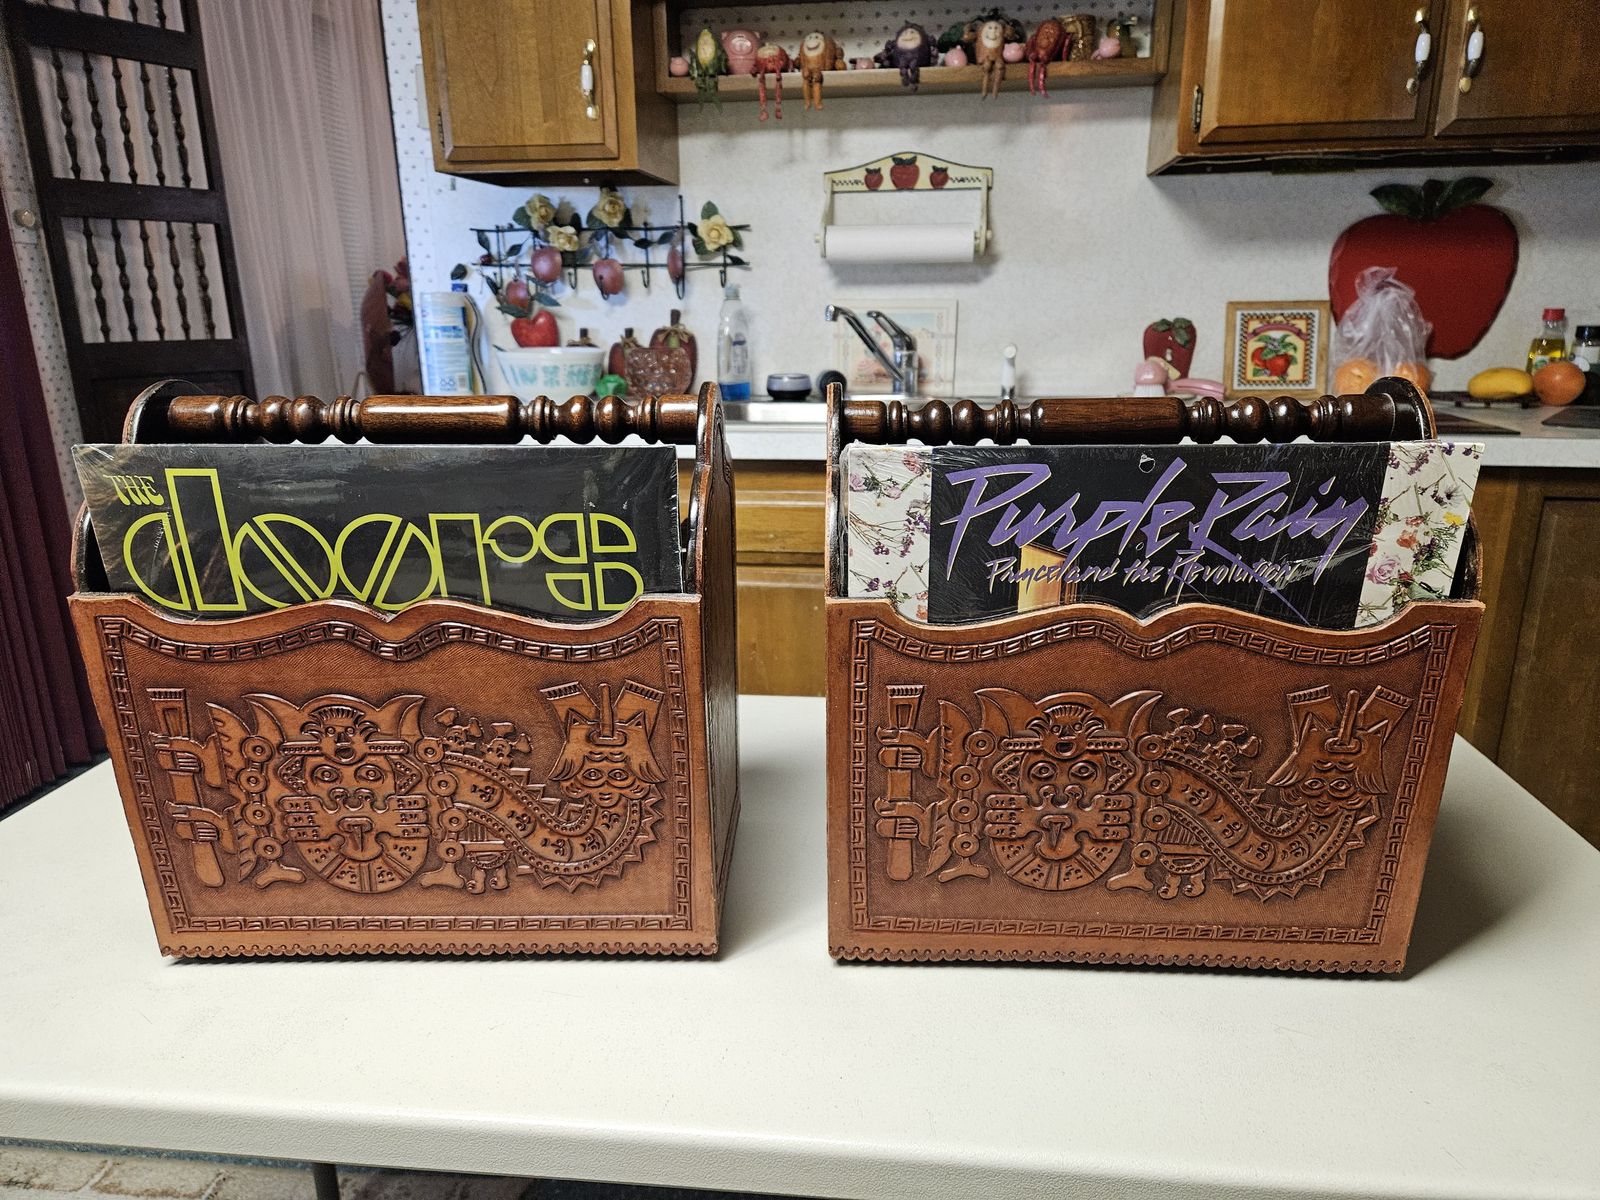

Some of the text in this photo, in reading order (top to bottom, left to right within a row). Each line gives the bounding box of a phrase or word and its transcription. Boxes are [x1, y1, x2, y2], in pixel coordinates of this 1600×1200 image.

[103, 474, 164, 506] THE
[123, 468, 645, 611] doors
[940, 457, 1370, 624] Purple Rain
[986, 549, 1297, 604] Prince and the Revolution
